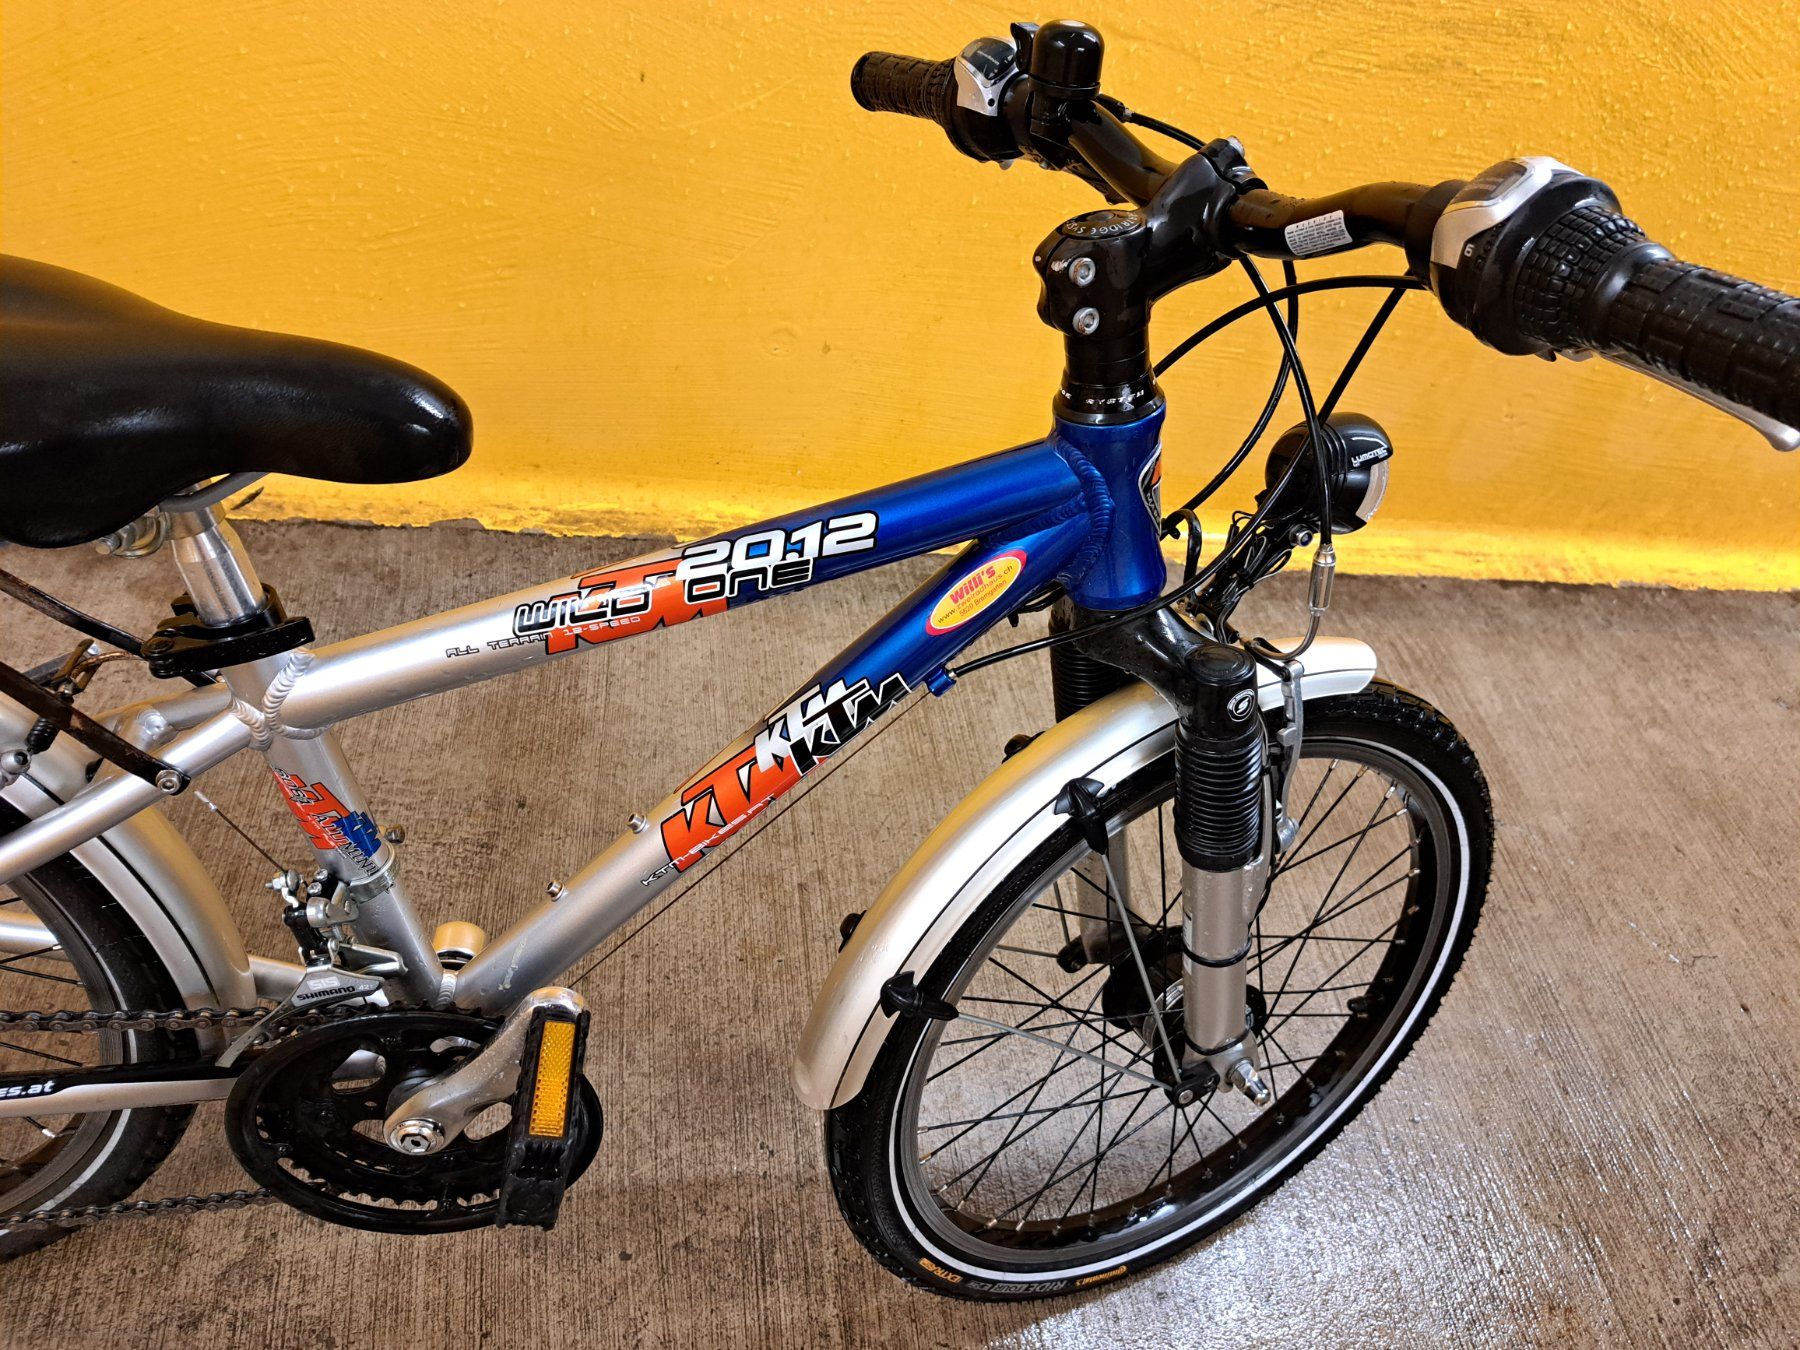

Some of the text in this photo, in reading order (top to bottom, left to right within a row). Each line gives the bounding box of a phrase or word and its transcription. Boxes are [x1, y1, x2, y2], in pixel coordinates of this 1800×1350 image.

[1464, 243, 1475, 257] 6
[1351, 447, 1387, 464] LUMOTEC
[949, 565, 996, 605] Willi's
[513, 556, 815, 637] WILD ONE
[446, 645, 479, 658] ALL
[487, 631, 553, 650] TERRAIN
[787, 672, 912, 777] KTM
[297, 986, 355, 1001] SHIMANO
[1027, 1279, 1068, 1292] RIDE
